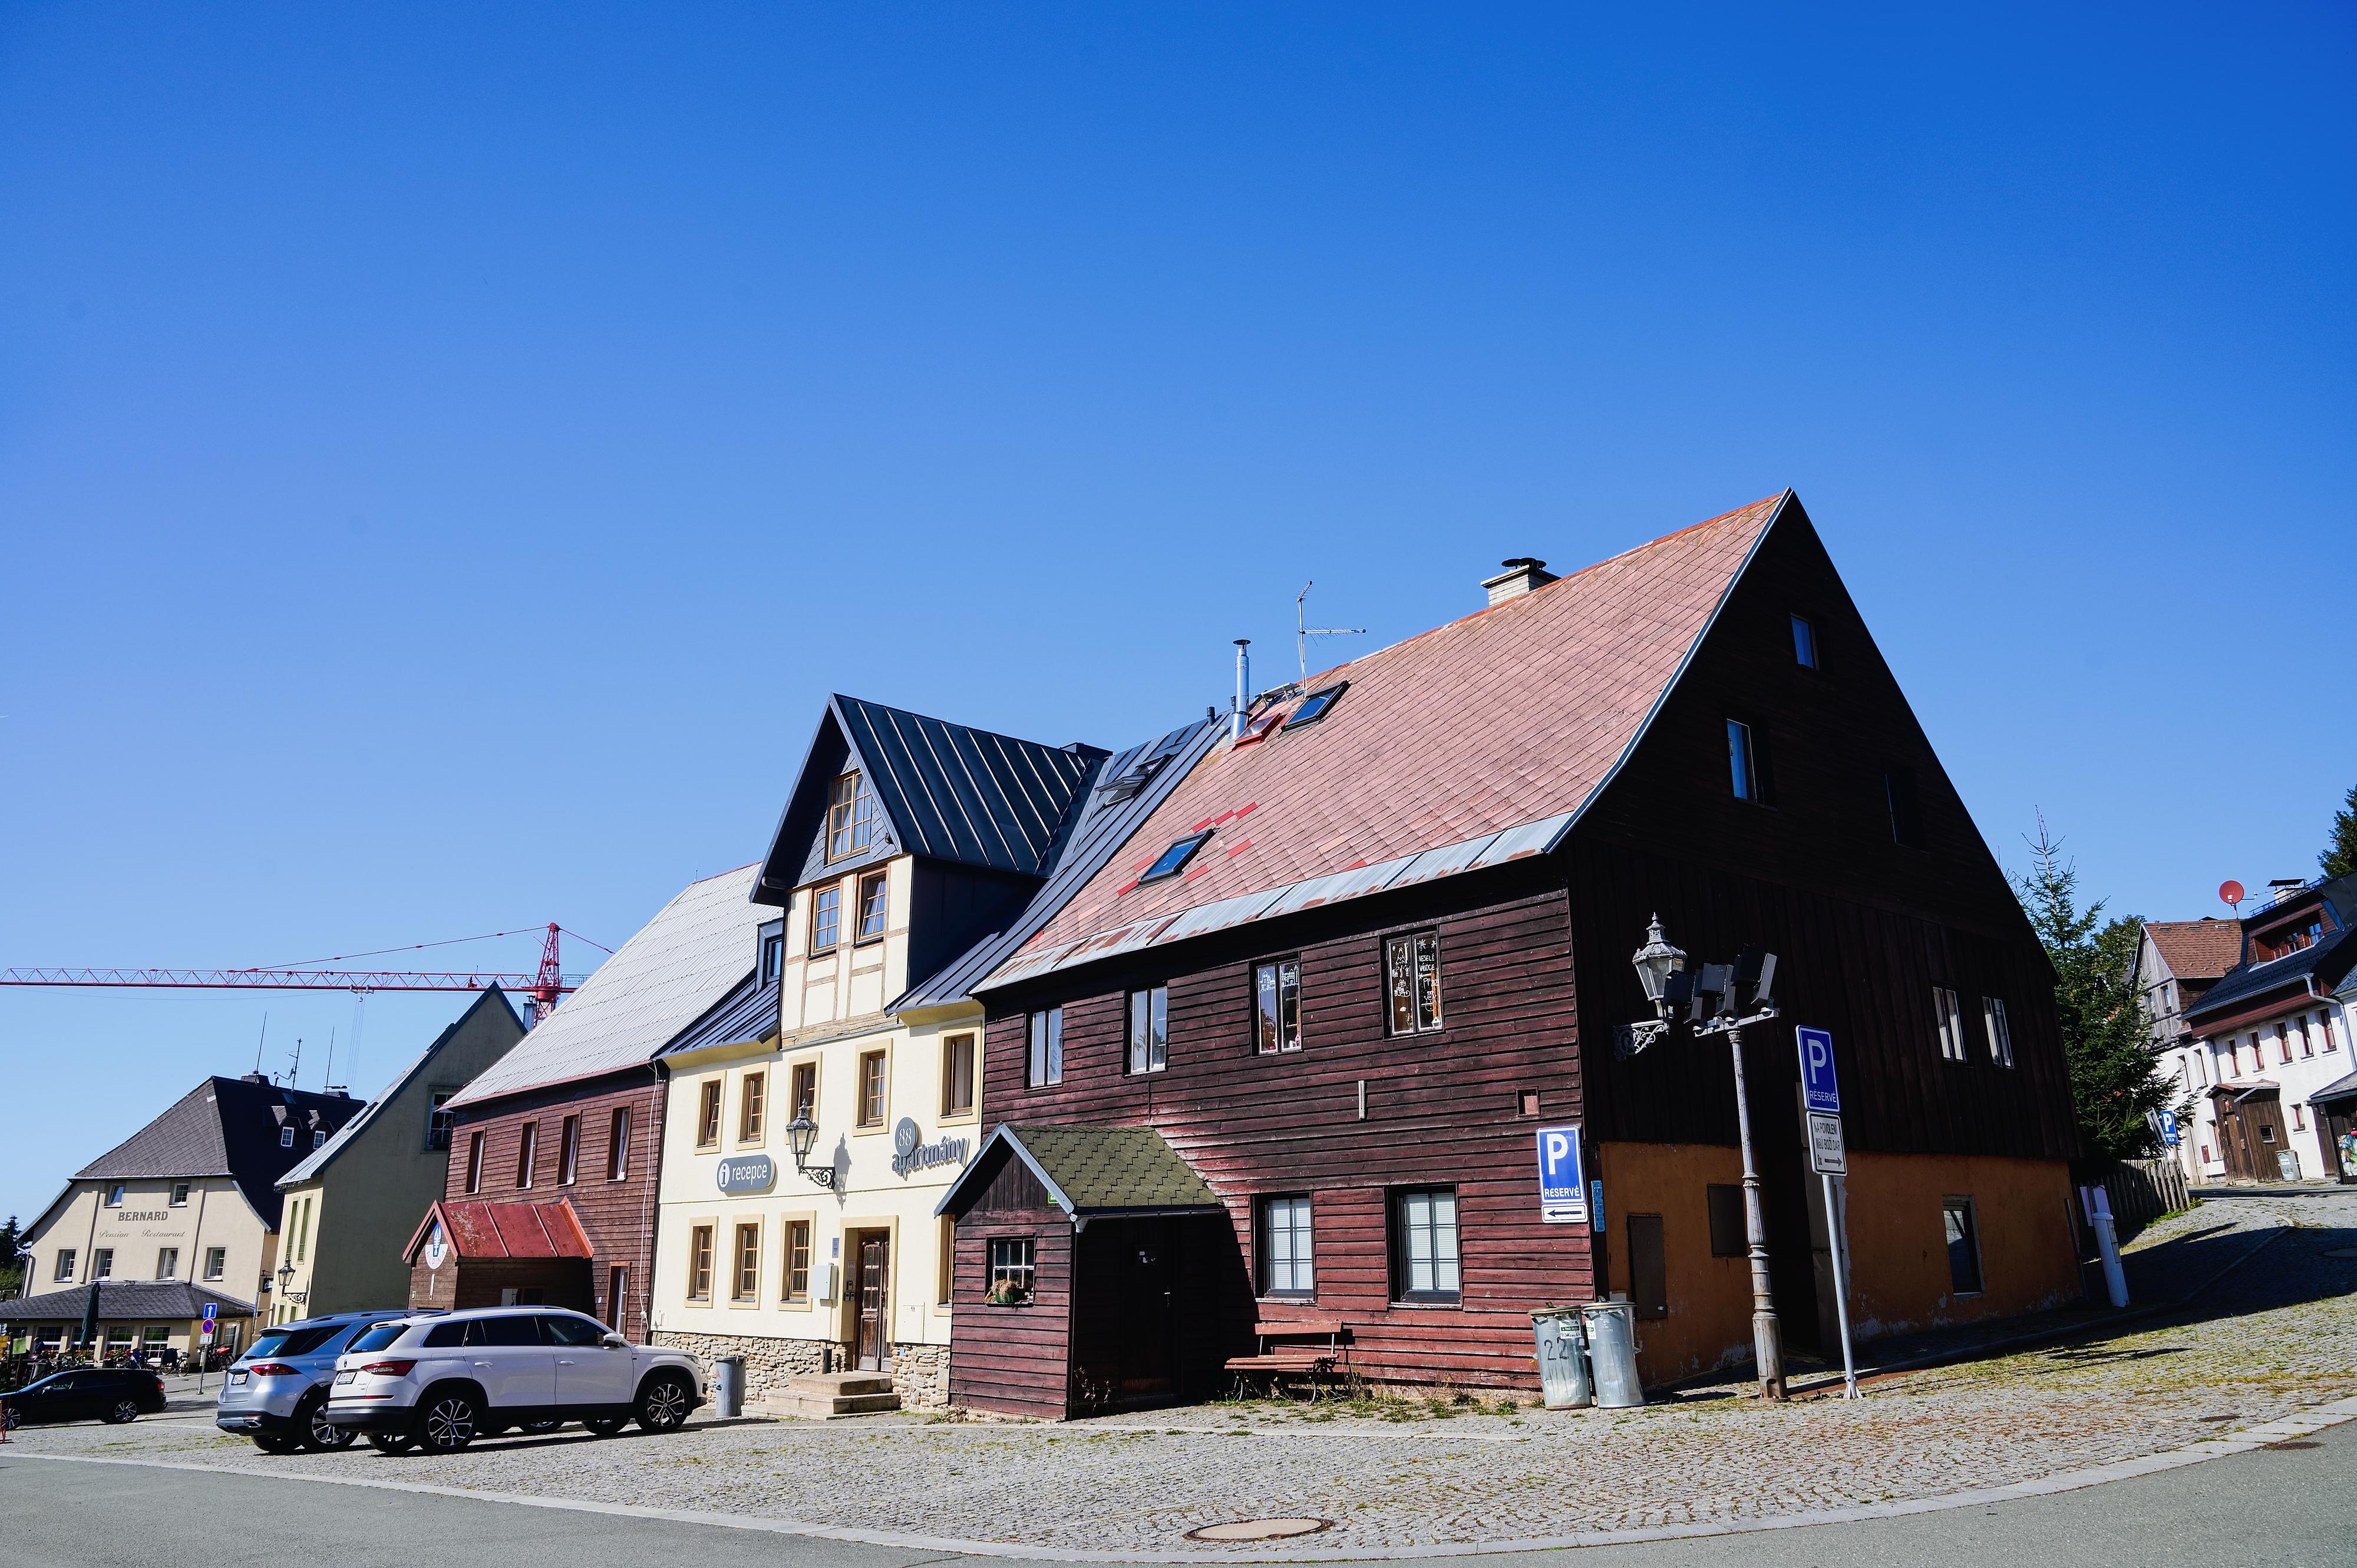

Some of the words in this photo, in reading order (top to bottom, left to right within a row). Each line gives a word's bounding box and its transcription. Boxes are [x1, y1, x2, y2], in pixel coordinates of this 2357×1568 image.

[1419, 953, 1435, 962] VESELÉ
[1807, 1039, 1827, 1084] P
[1809, 1089, 1837, 1102] RÉSERVÉ
[1814, 1122, 1820, 1133] NA
[1820, 1122, 1837, 1135] POVOLENÍ
[2163, 1113, 2173, 1132] P
[899, 1127, 912, 1147] 88
[1832, 1140, 1841, 1151] DAR
[892, 1135, 966, 1177] apartmány
[1546, 1133, 1569, 1175] P
[732, 1164, 767, 1186] recepce
[1544, 1185, 1580, 1197] RESERVÉ
[118, 1211, 169, 1222] BERNARD
[98, 1230, 129, 1238] Pension
[141, 1229, 186, 1237] Restaurant
[1544, 1336, 1569, 1361] 22
